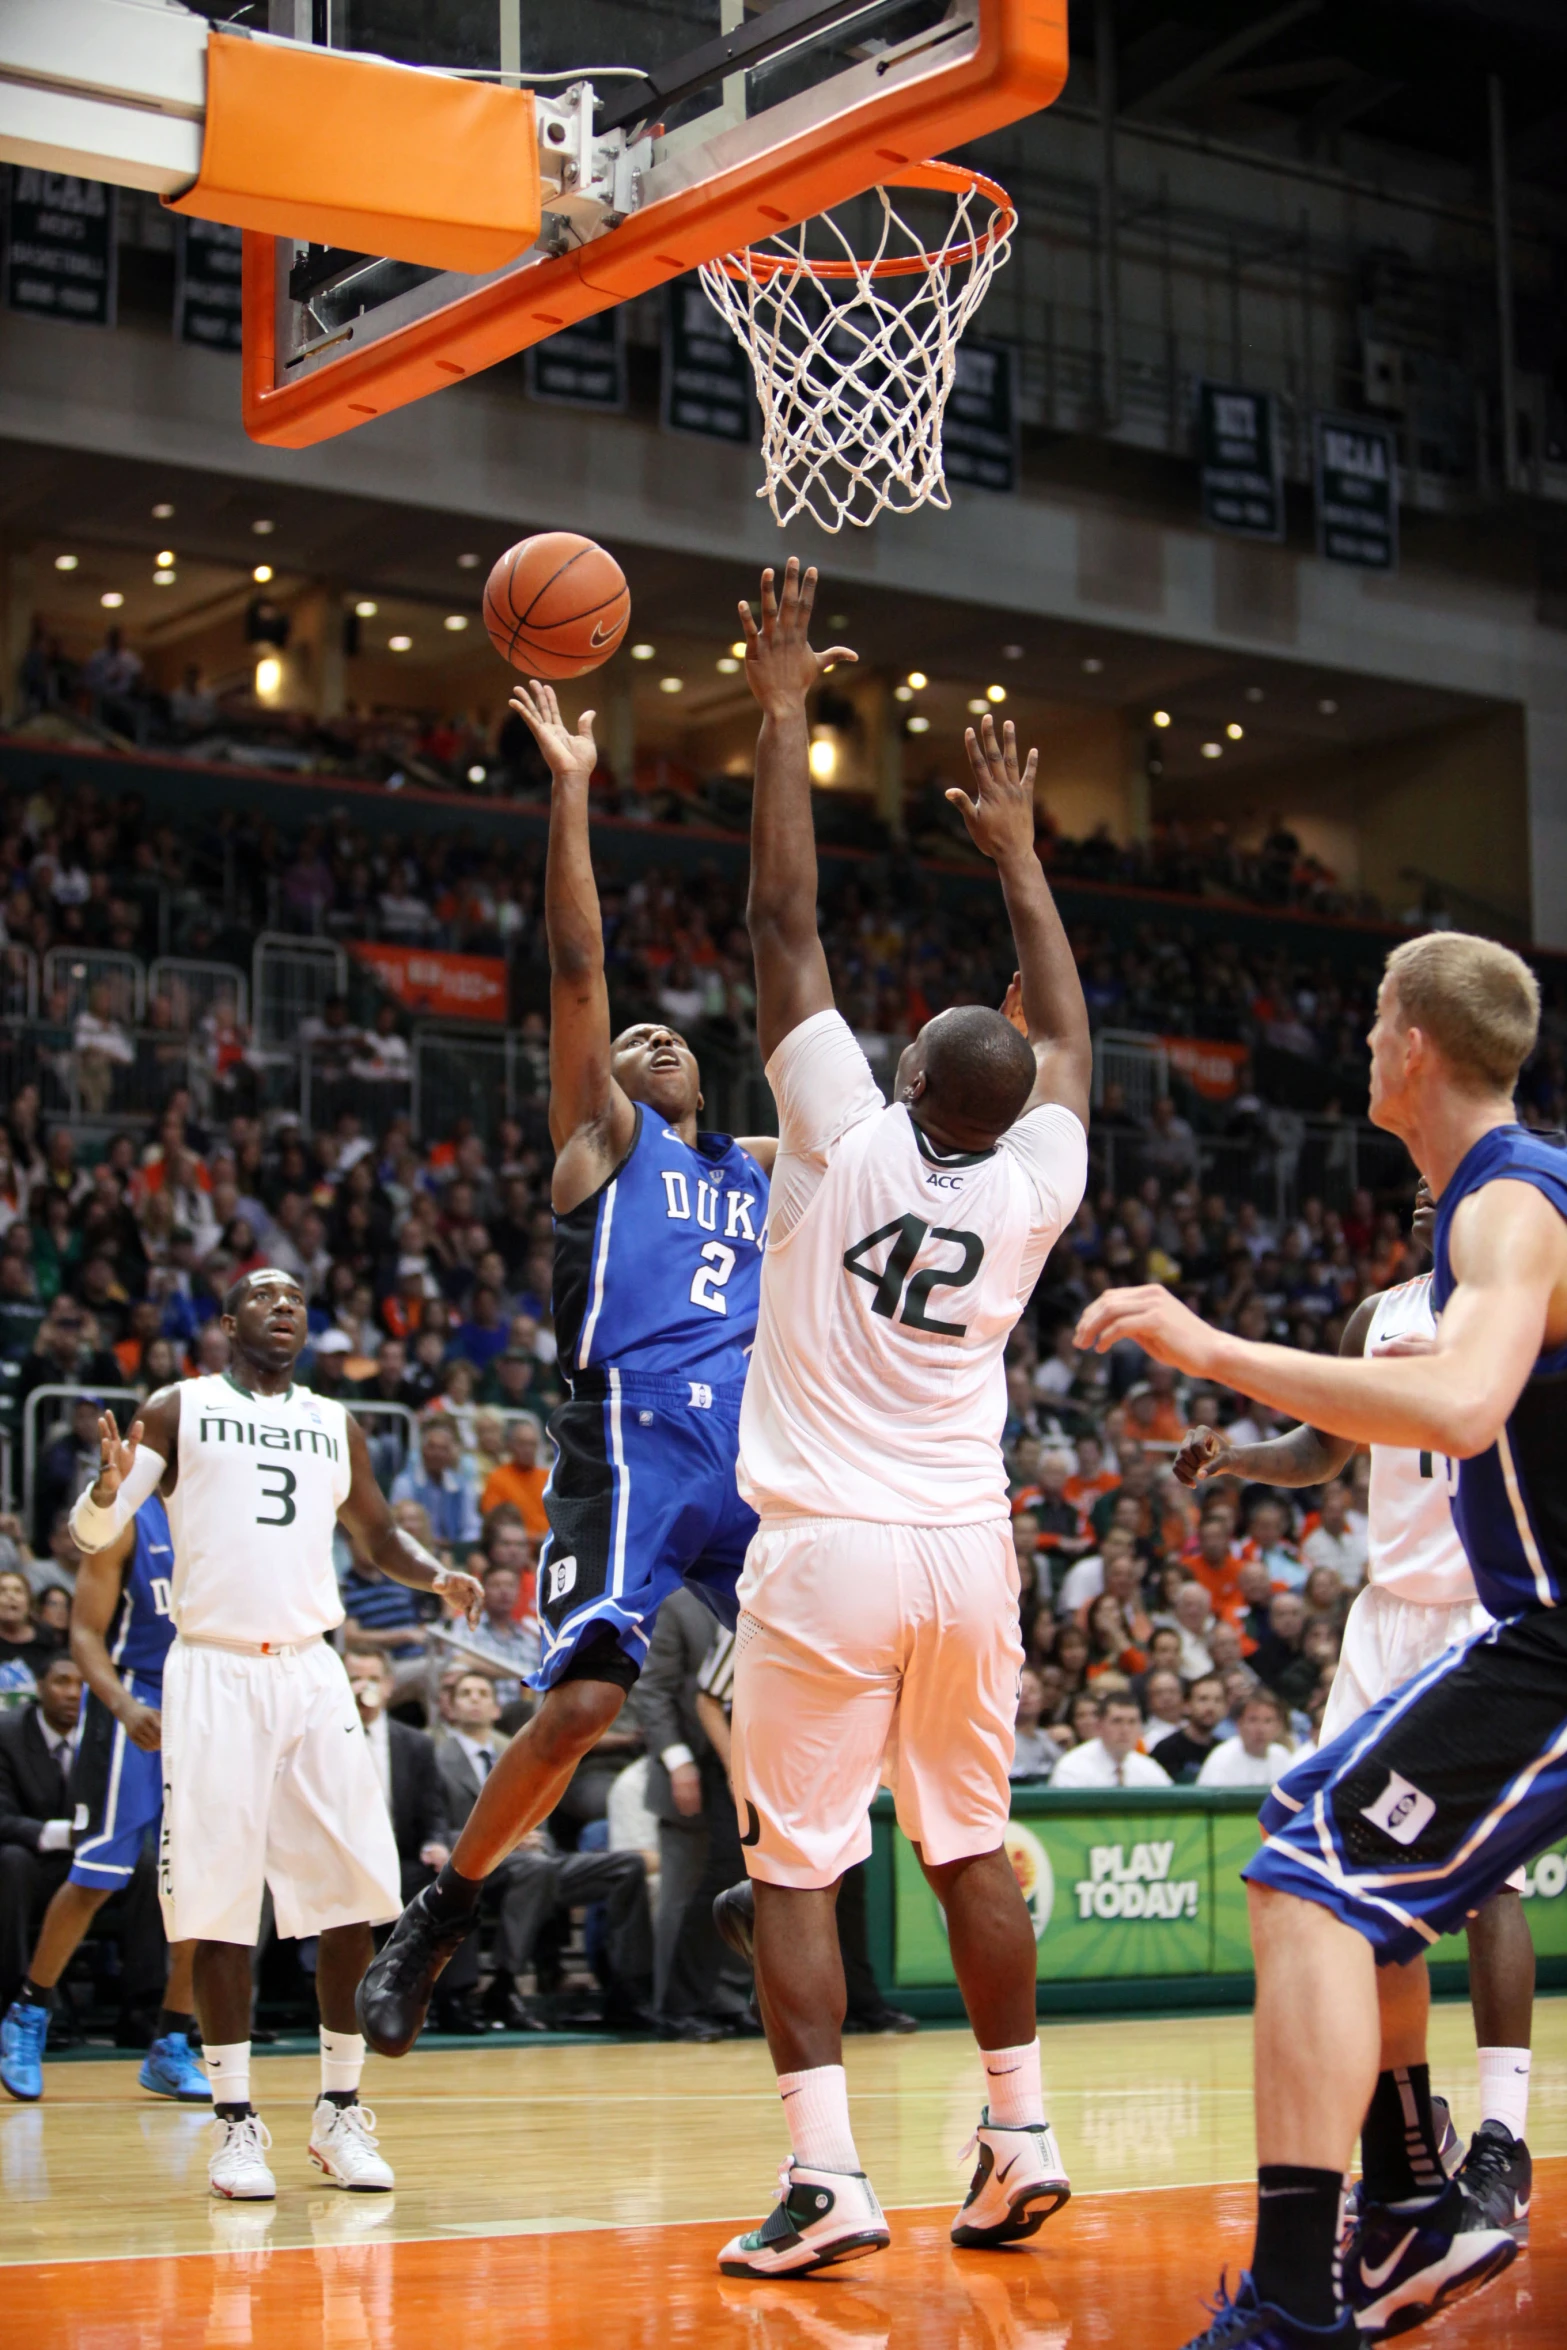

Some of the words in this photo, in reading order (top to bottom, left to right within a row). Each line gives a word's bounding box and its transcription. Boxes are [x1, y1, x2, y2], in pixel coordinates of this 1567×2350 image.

[661, 1171, 768, 1253] DUK
[926, 1173, 964, 1190] ACC
[690, 1240, 737, 1316] 2
[843, 1212, 985, 1338] 42
[256, 1463, 297, 1527] 3
[1089, 1841, 1174, 1882] PLAY
[1075, 1880, 1199, 1919] TODAY!
